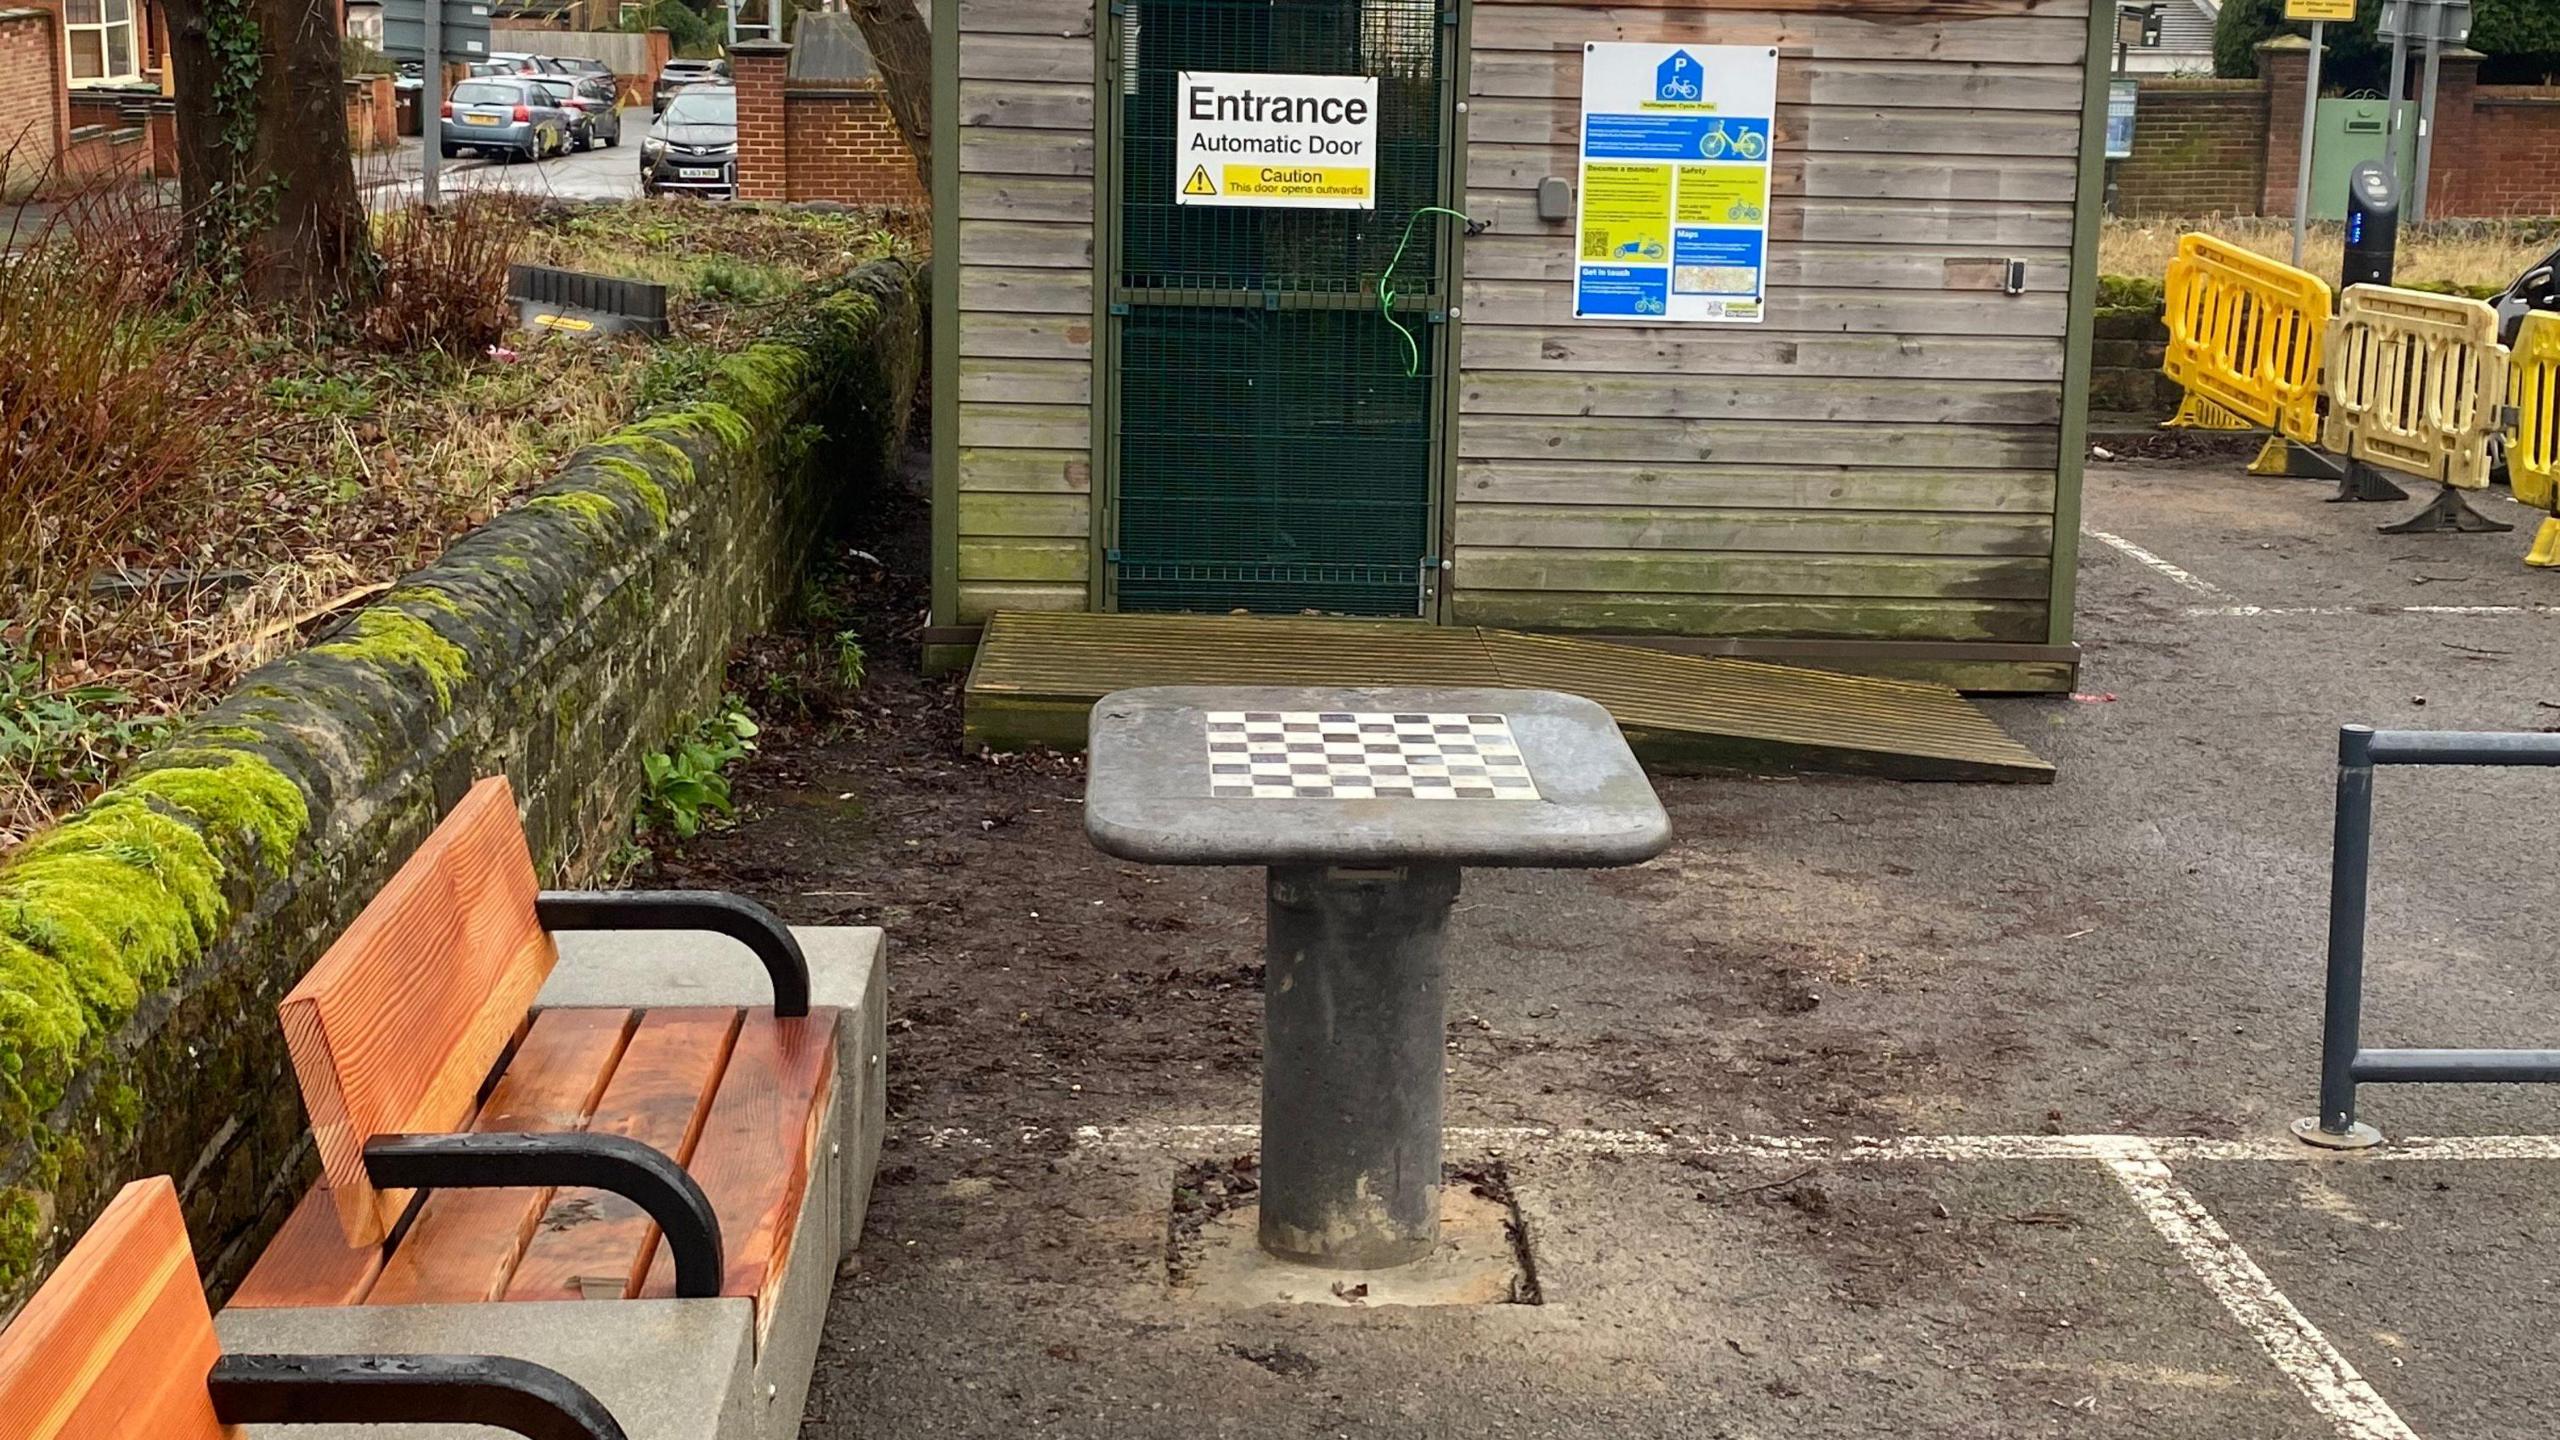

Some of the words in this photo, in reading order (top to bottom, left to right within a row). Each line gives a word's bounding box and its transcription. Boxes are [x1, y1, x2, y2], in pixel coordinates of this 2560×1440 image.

[1674, 58, 1687, 72] P
[1189, 86, 1368, 125] Entrance
[1190, 132, 1302, 154] Automatic
[1309, 135, 1362, 155] Door
[1587, 164, 1618, 172] Become
[1681, 167, 1707, 175] Safety
[1260, 168, 1323, 184] Caution
[1230, 182, 1252, 193] This
[1253, 183, 1279, 193] door
[1281, 184, 1314, 196] opens
[1315, 186, 1364, 195] outwards
[1677, 230, 1699, 239] Maps
[1582, 268, 1597, 276] Get
[1598, 268, 1607, 276] in
[1607, 269, 1631, 277] touch
